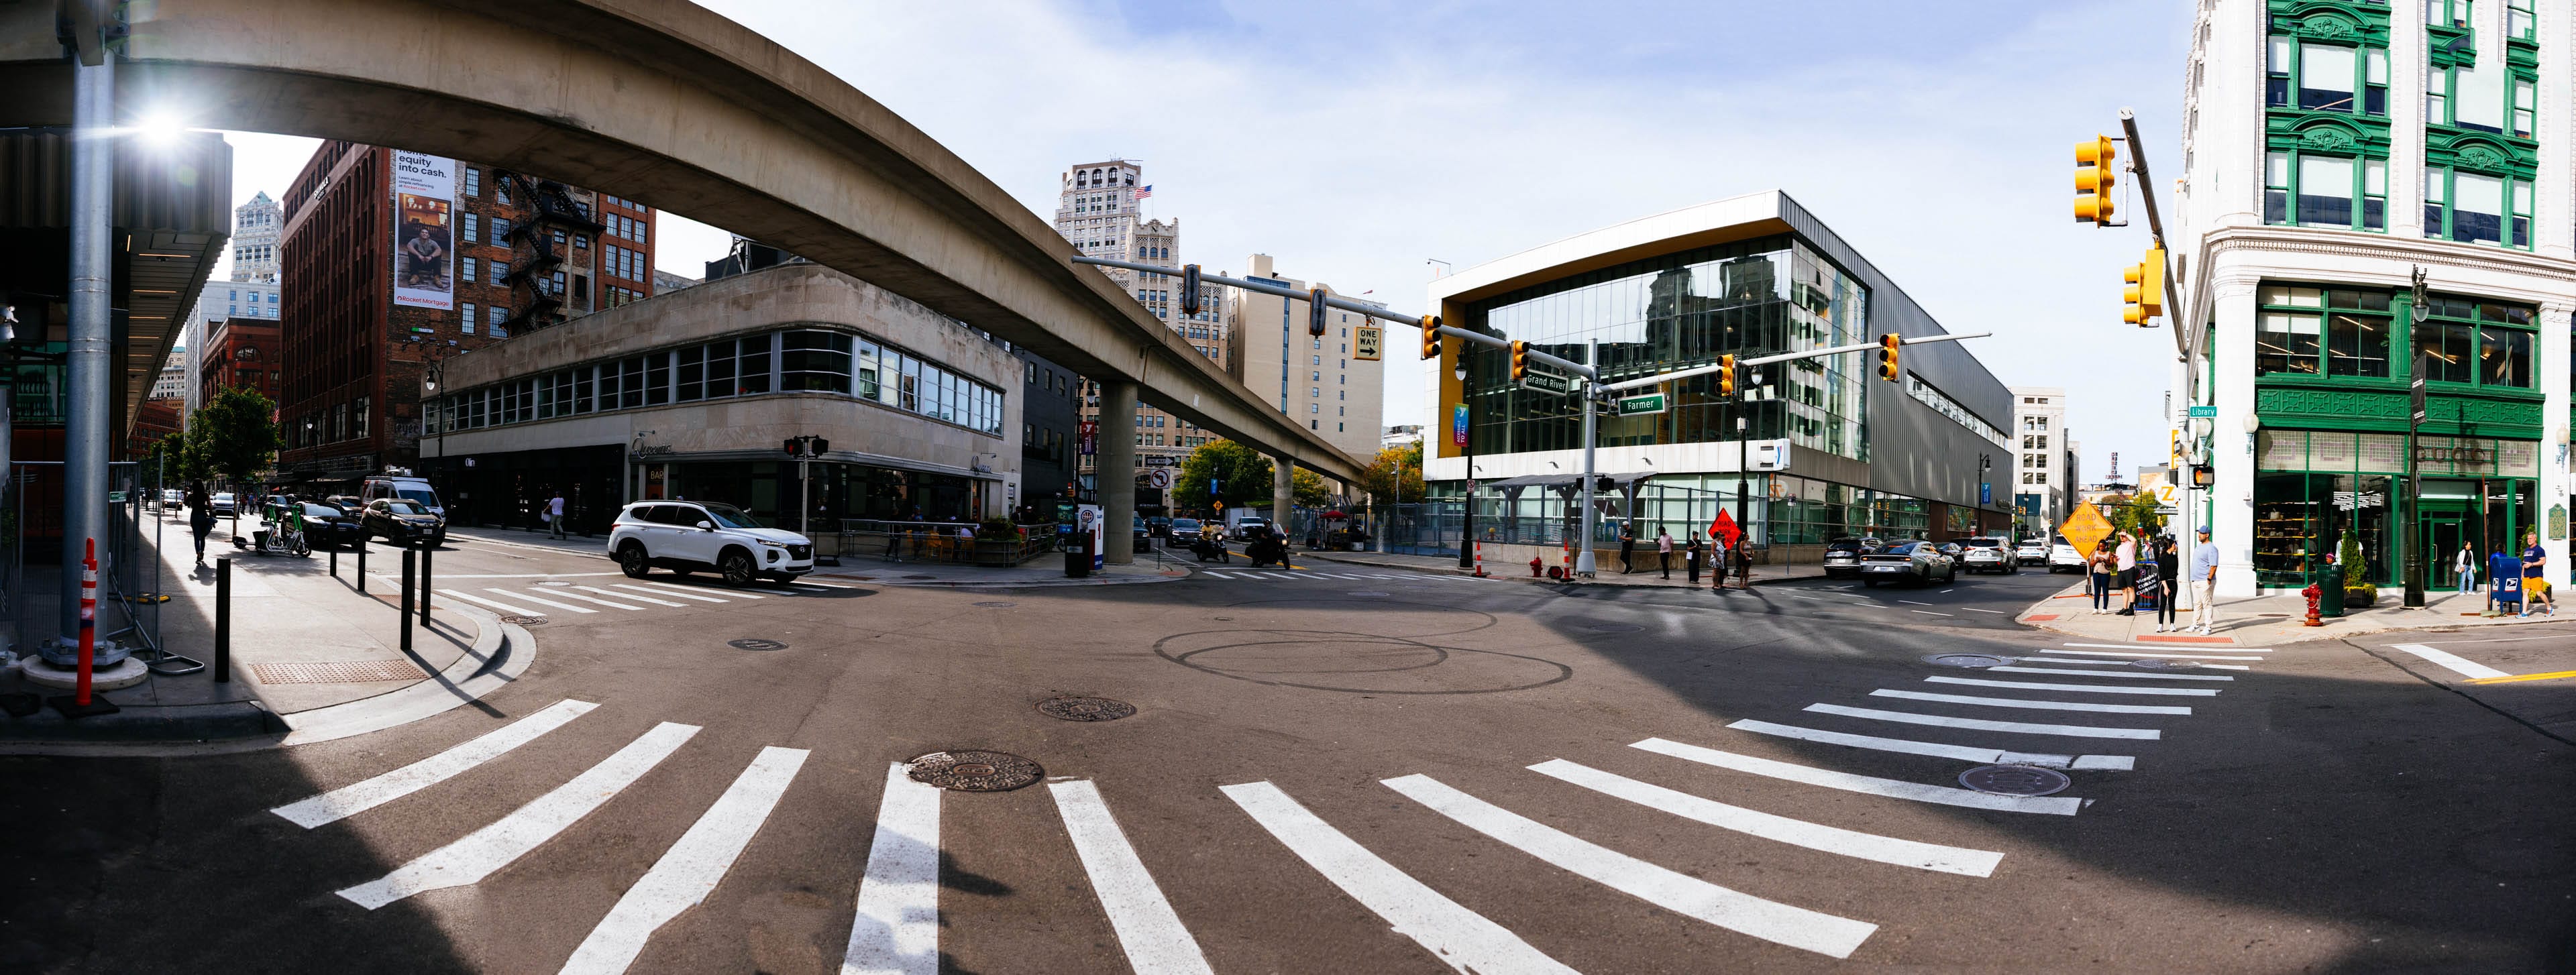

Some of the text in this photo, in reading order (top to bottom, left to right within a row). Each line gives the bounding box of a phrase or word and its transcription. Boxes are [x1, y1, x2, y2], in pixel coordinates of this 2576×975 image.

[399, 156, 431, 168] equity
[399, 163, 447, 178] into cash.
[422, 298, 449, 307] Mortgage
[1360, 329, 1377, 338] ONE
[1360, 337, 1377, 346] WAY
[1527, 374, 1566, 390] Grand River
[1627, 400, 1654, 410] Farmer
[2192, 408, 2214, 416] Library
[651, 471, 663, 479] BAR
[2136, 583, 2157, 595] CUISINE
[2138, 579, 2156, 589] CUBAN
